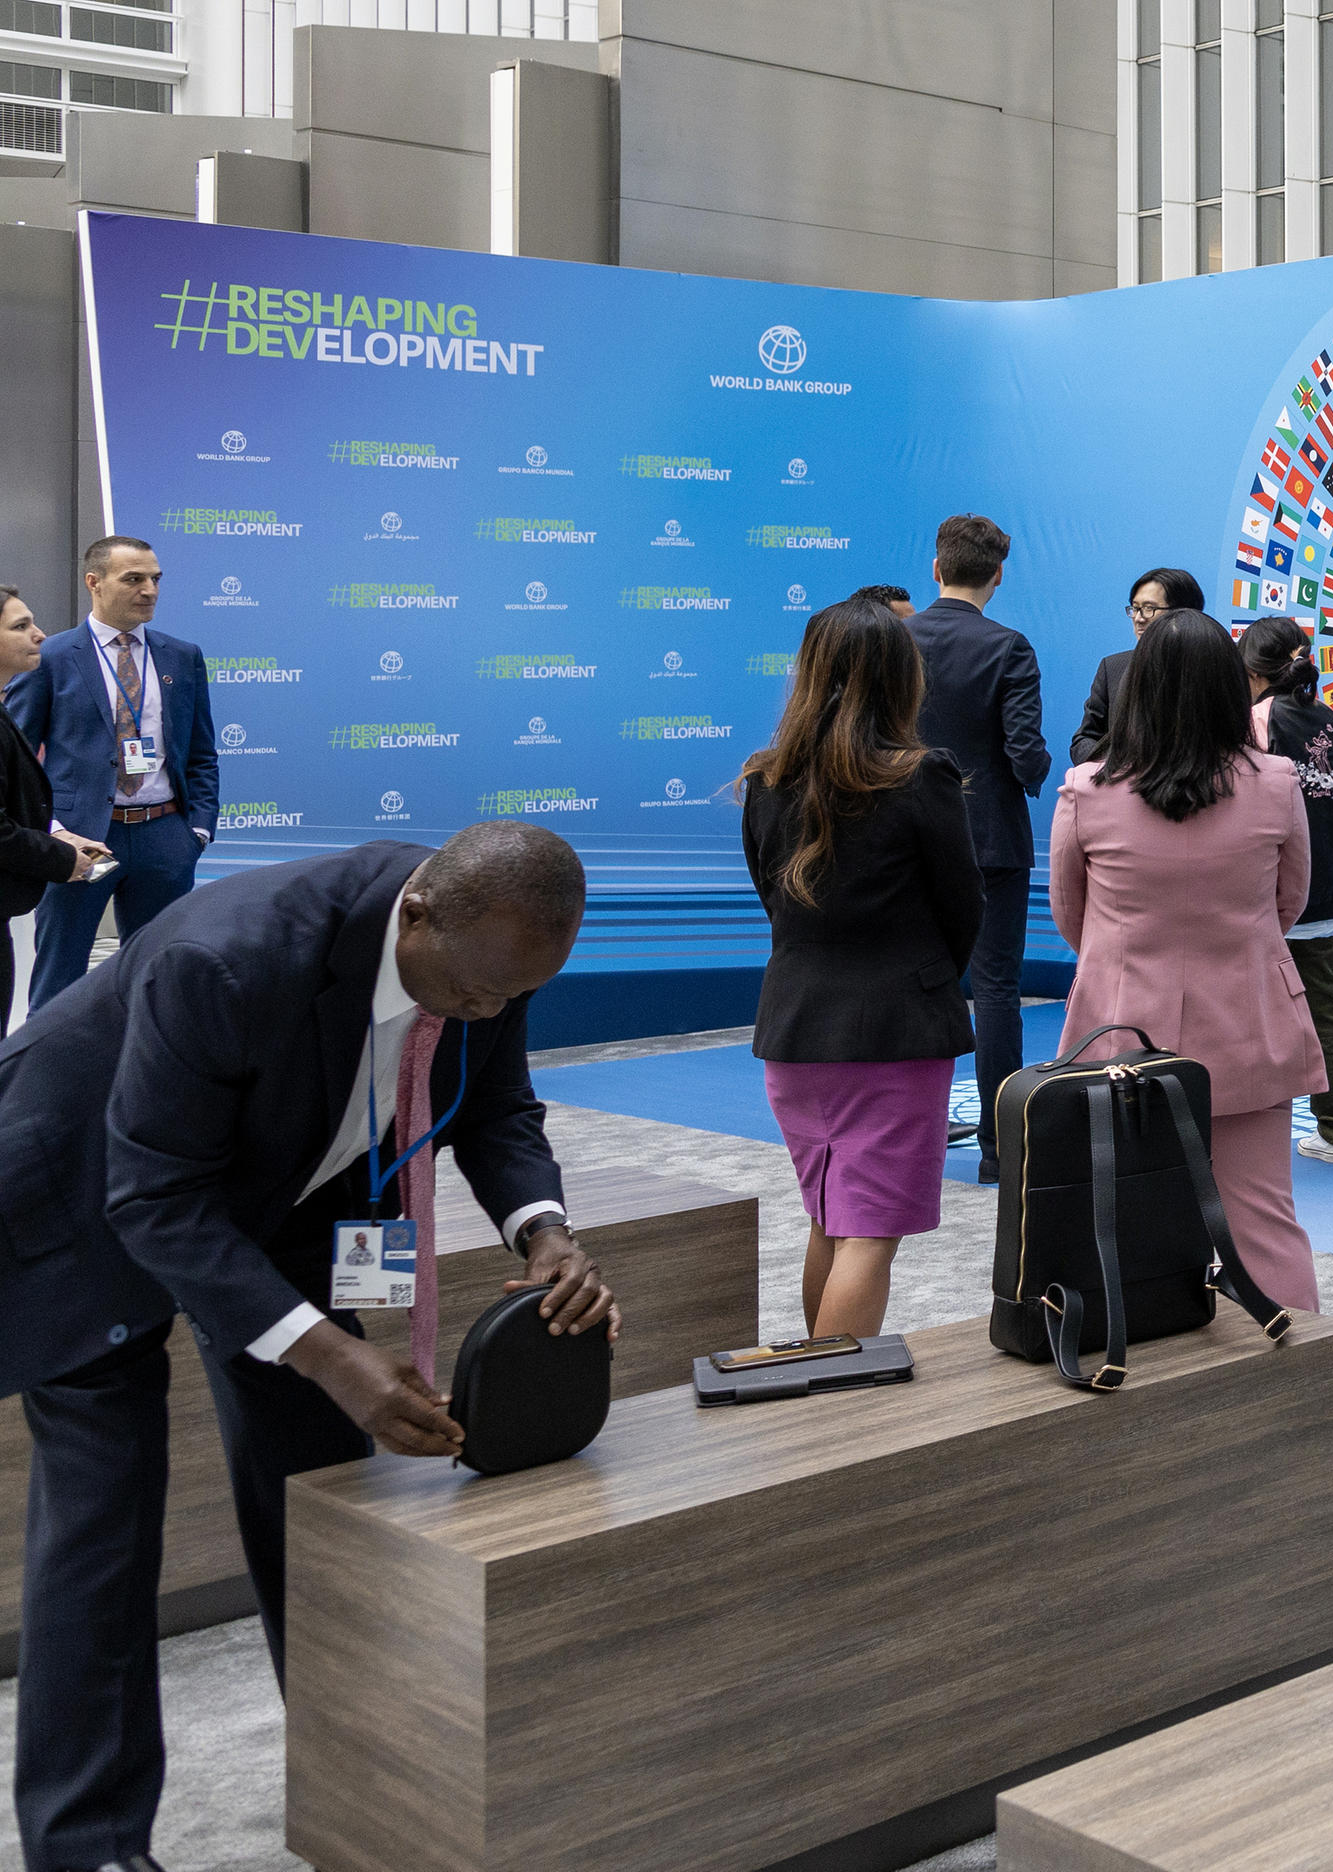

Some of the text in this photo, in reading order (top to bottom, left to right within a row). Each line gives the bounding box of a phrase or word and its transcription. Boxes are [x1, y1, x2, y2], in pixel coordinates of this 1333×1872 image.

[227, 321, 544, 376] DEVELOPMENT
[710, 374, 852, 395] WORLD BANK GROUP
[197, 453, 271, 463] WORLD BANK GROUP
[350, 453, 460, 470] DEVELOPMENT
[637, 467, 732, 480] DEVELOPMENT
[184, 521, 303, 536] DEVELOPMENT
[494, 529, 597, 544] DEVELOPMENT
[762, 537, 850, 549] DEVELOPMENT
[350, 596, 459, 609] DEVELOPMENT
[637, 598, 731, 610] DEVELOPMENT
[496, 666, 597, 679] DEVELOPMENT
[638, 726, 732, 740] DEVELOPMENT
[350, 734, 460, 749] DEVELOPMENT
[497, 798, 599, 815] DEVELOPMENT
